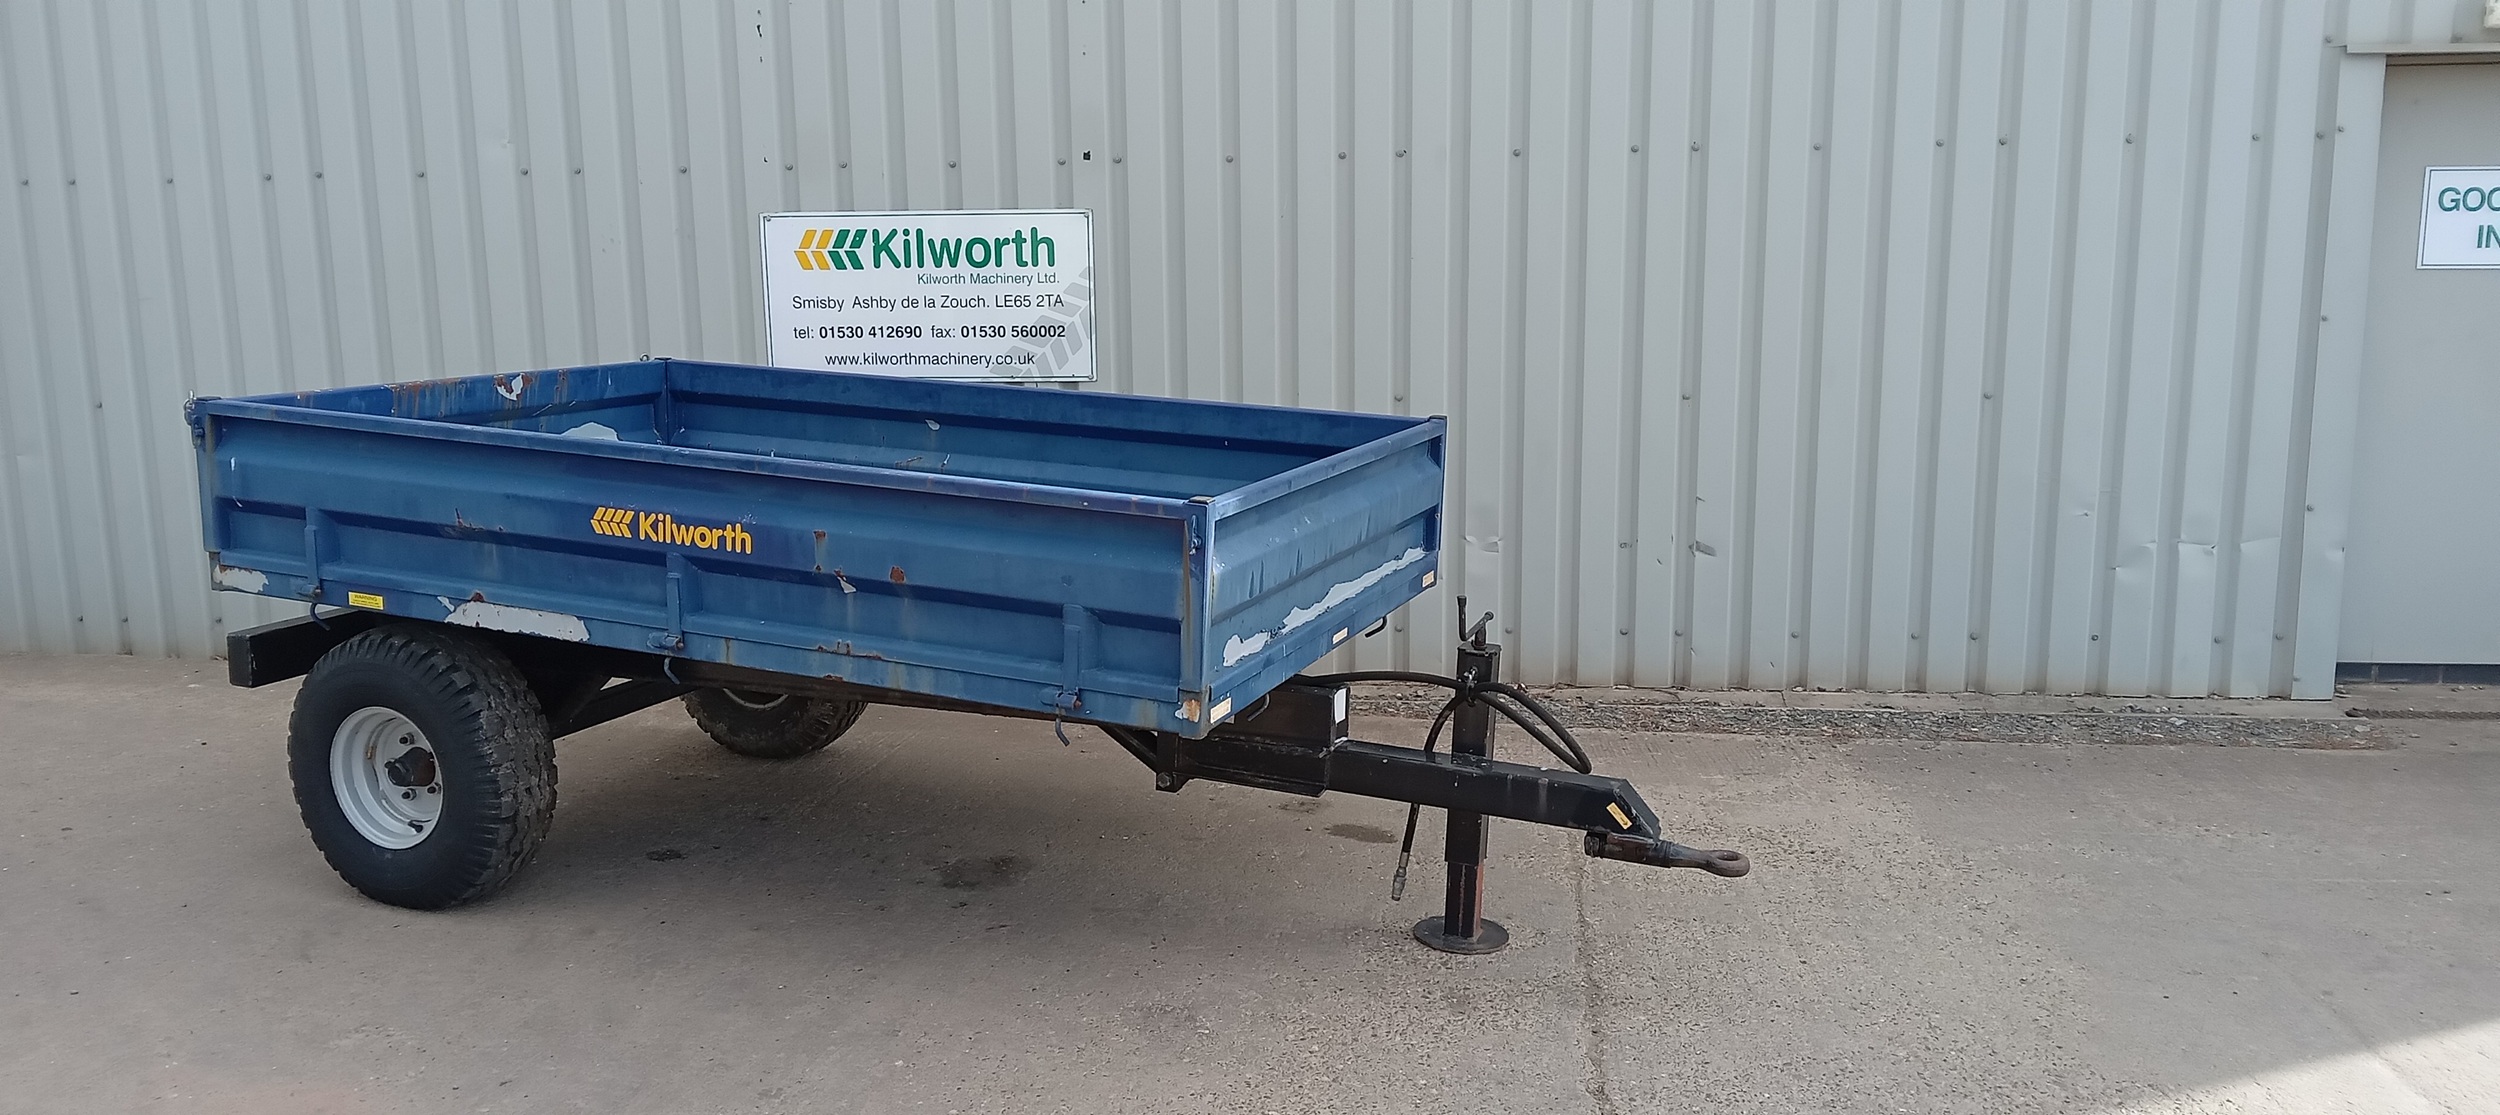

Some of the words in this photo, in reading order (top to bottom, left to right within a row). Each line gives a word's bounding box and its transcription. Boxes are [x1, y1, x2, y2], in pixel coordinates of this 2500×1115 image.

[872, 226, 1056, 269] Kilworth
[917, 273, 966, 284] Kilworth
[970, 272, 1033, 286] Machinery
[1037, 272, 1060, 284] Ltd.
[792, 295, 845, 312] Smisby
[852, 295, 897, 312] Ashby
[901, 295, 920, 309] de
[923, 295, 936, 309] la
[940, 294, 990, 308] Zouch.
[995, 294, 1032, 308] LE65
[1036, 294, 1065, 307] 2TA
[793, 325, 815, 339] tel:
[819, 325, 864, 339] 01530
[868, 325, 922, 338] 412690
[930, 325, 956, 338] fax:
[960, 325, 1006, 338] 01530
[1011, 324, 1066, 338] 560002
[825, 351, 1036, 369] www.kilworthmachinery.co.uk
[638, 511, 752, 554] Kilworth
